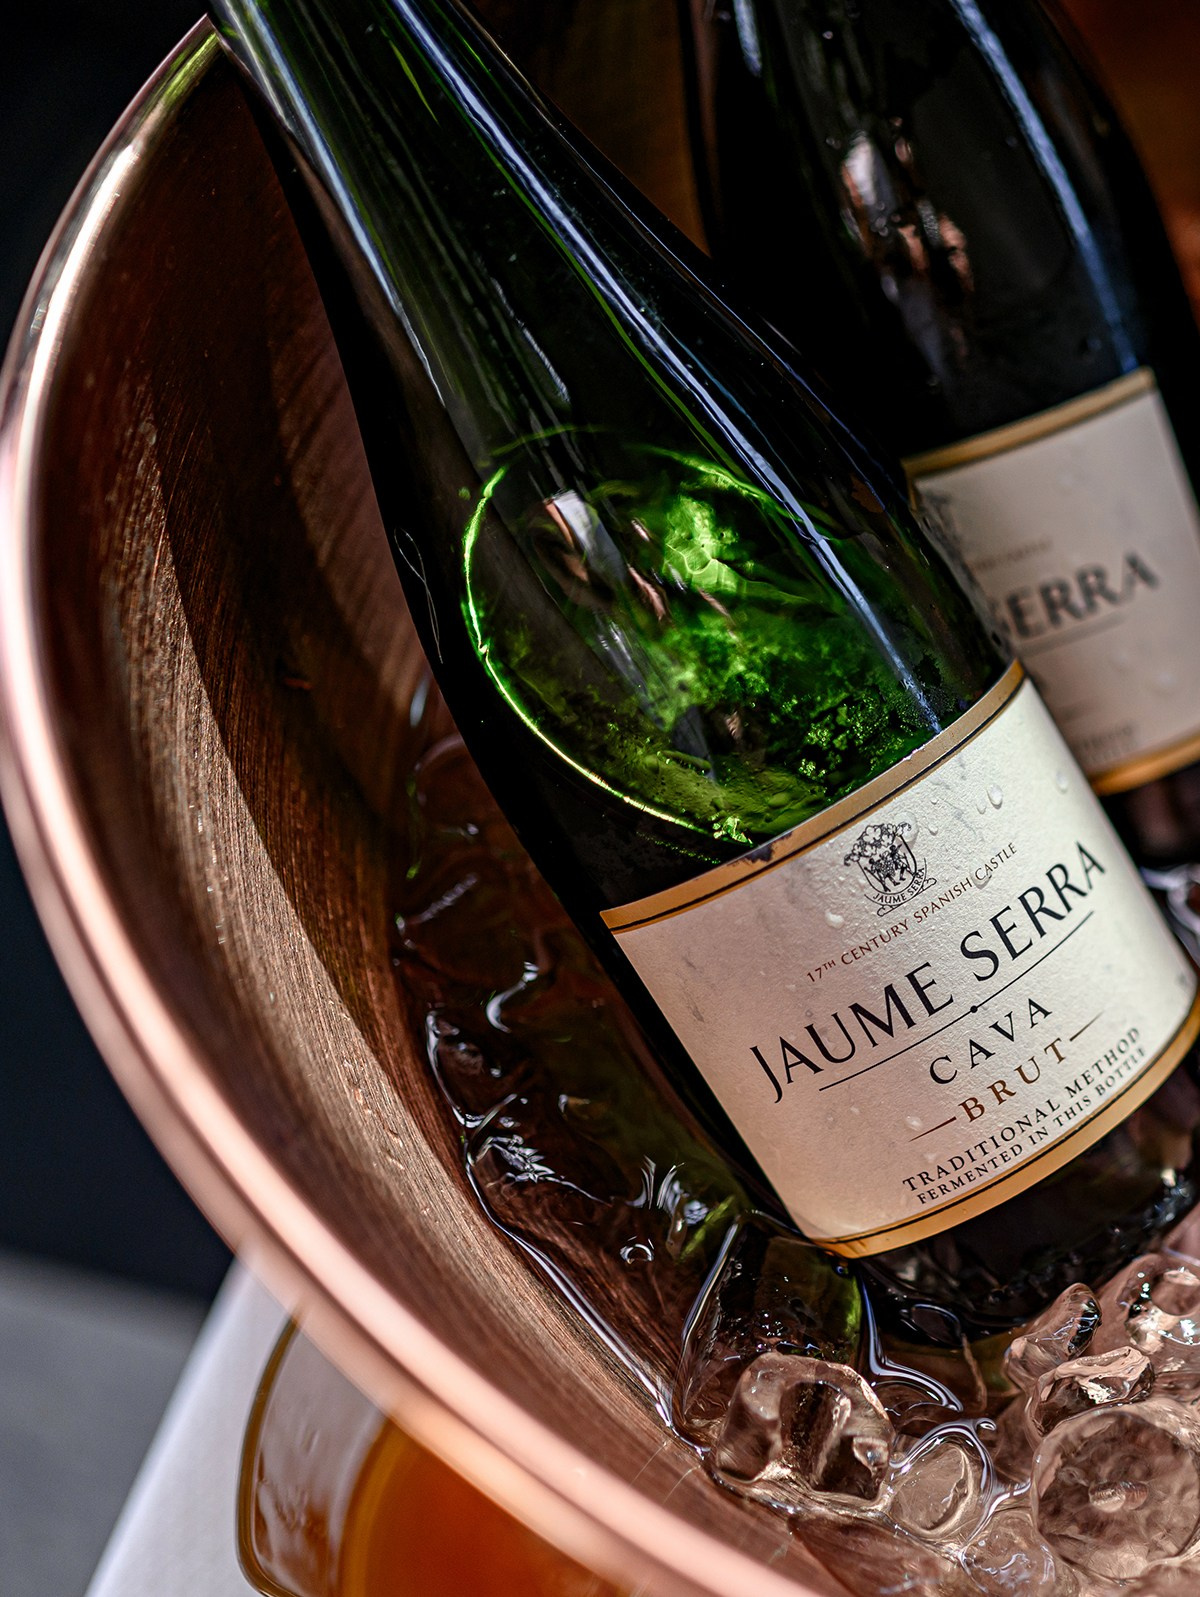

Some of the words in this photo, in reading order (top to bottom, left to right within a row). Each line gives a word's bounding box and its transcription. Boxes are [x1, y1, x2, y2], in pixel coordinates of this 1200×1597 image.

[806, 959, 837, 983] 17TH
[840, 918, 910, 966] CENTURY
[913, 877, 973, 924] SPANISH
[974, 842, 1018, 882] CASTLE
[872, 893, 907, 904] JAUME
[749, 961, 955, 1104] JAUME
[959, 840, 1106, 982] SERRA
[928, 997, 1053, 1085] CAVA
[957, 1036, 1067, 1123] BRUT
[902, 1098, 1061, 1192] TRADITIONAL
[1064, 1026, 1140, 1099] METHOD
[916, 1143, 1024, 1205] FERMENTED
[1028, 1125, 1050, 1146] IN
[1052, 1094, 1092, 1128] THIS
